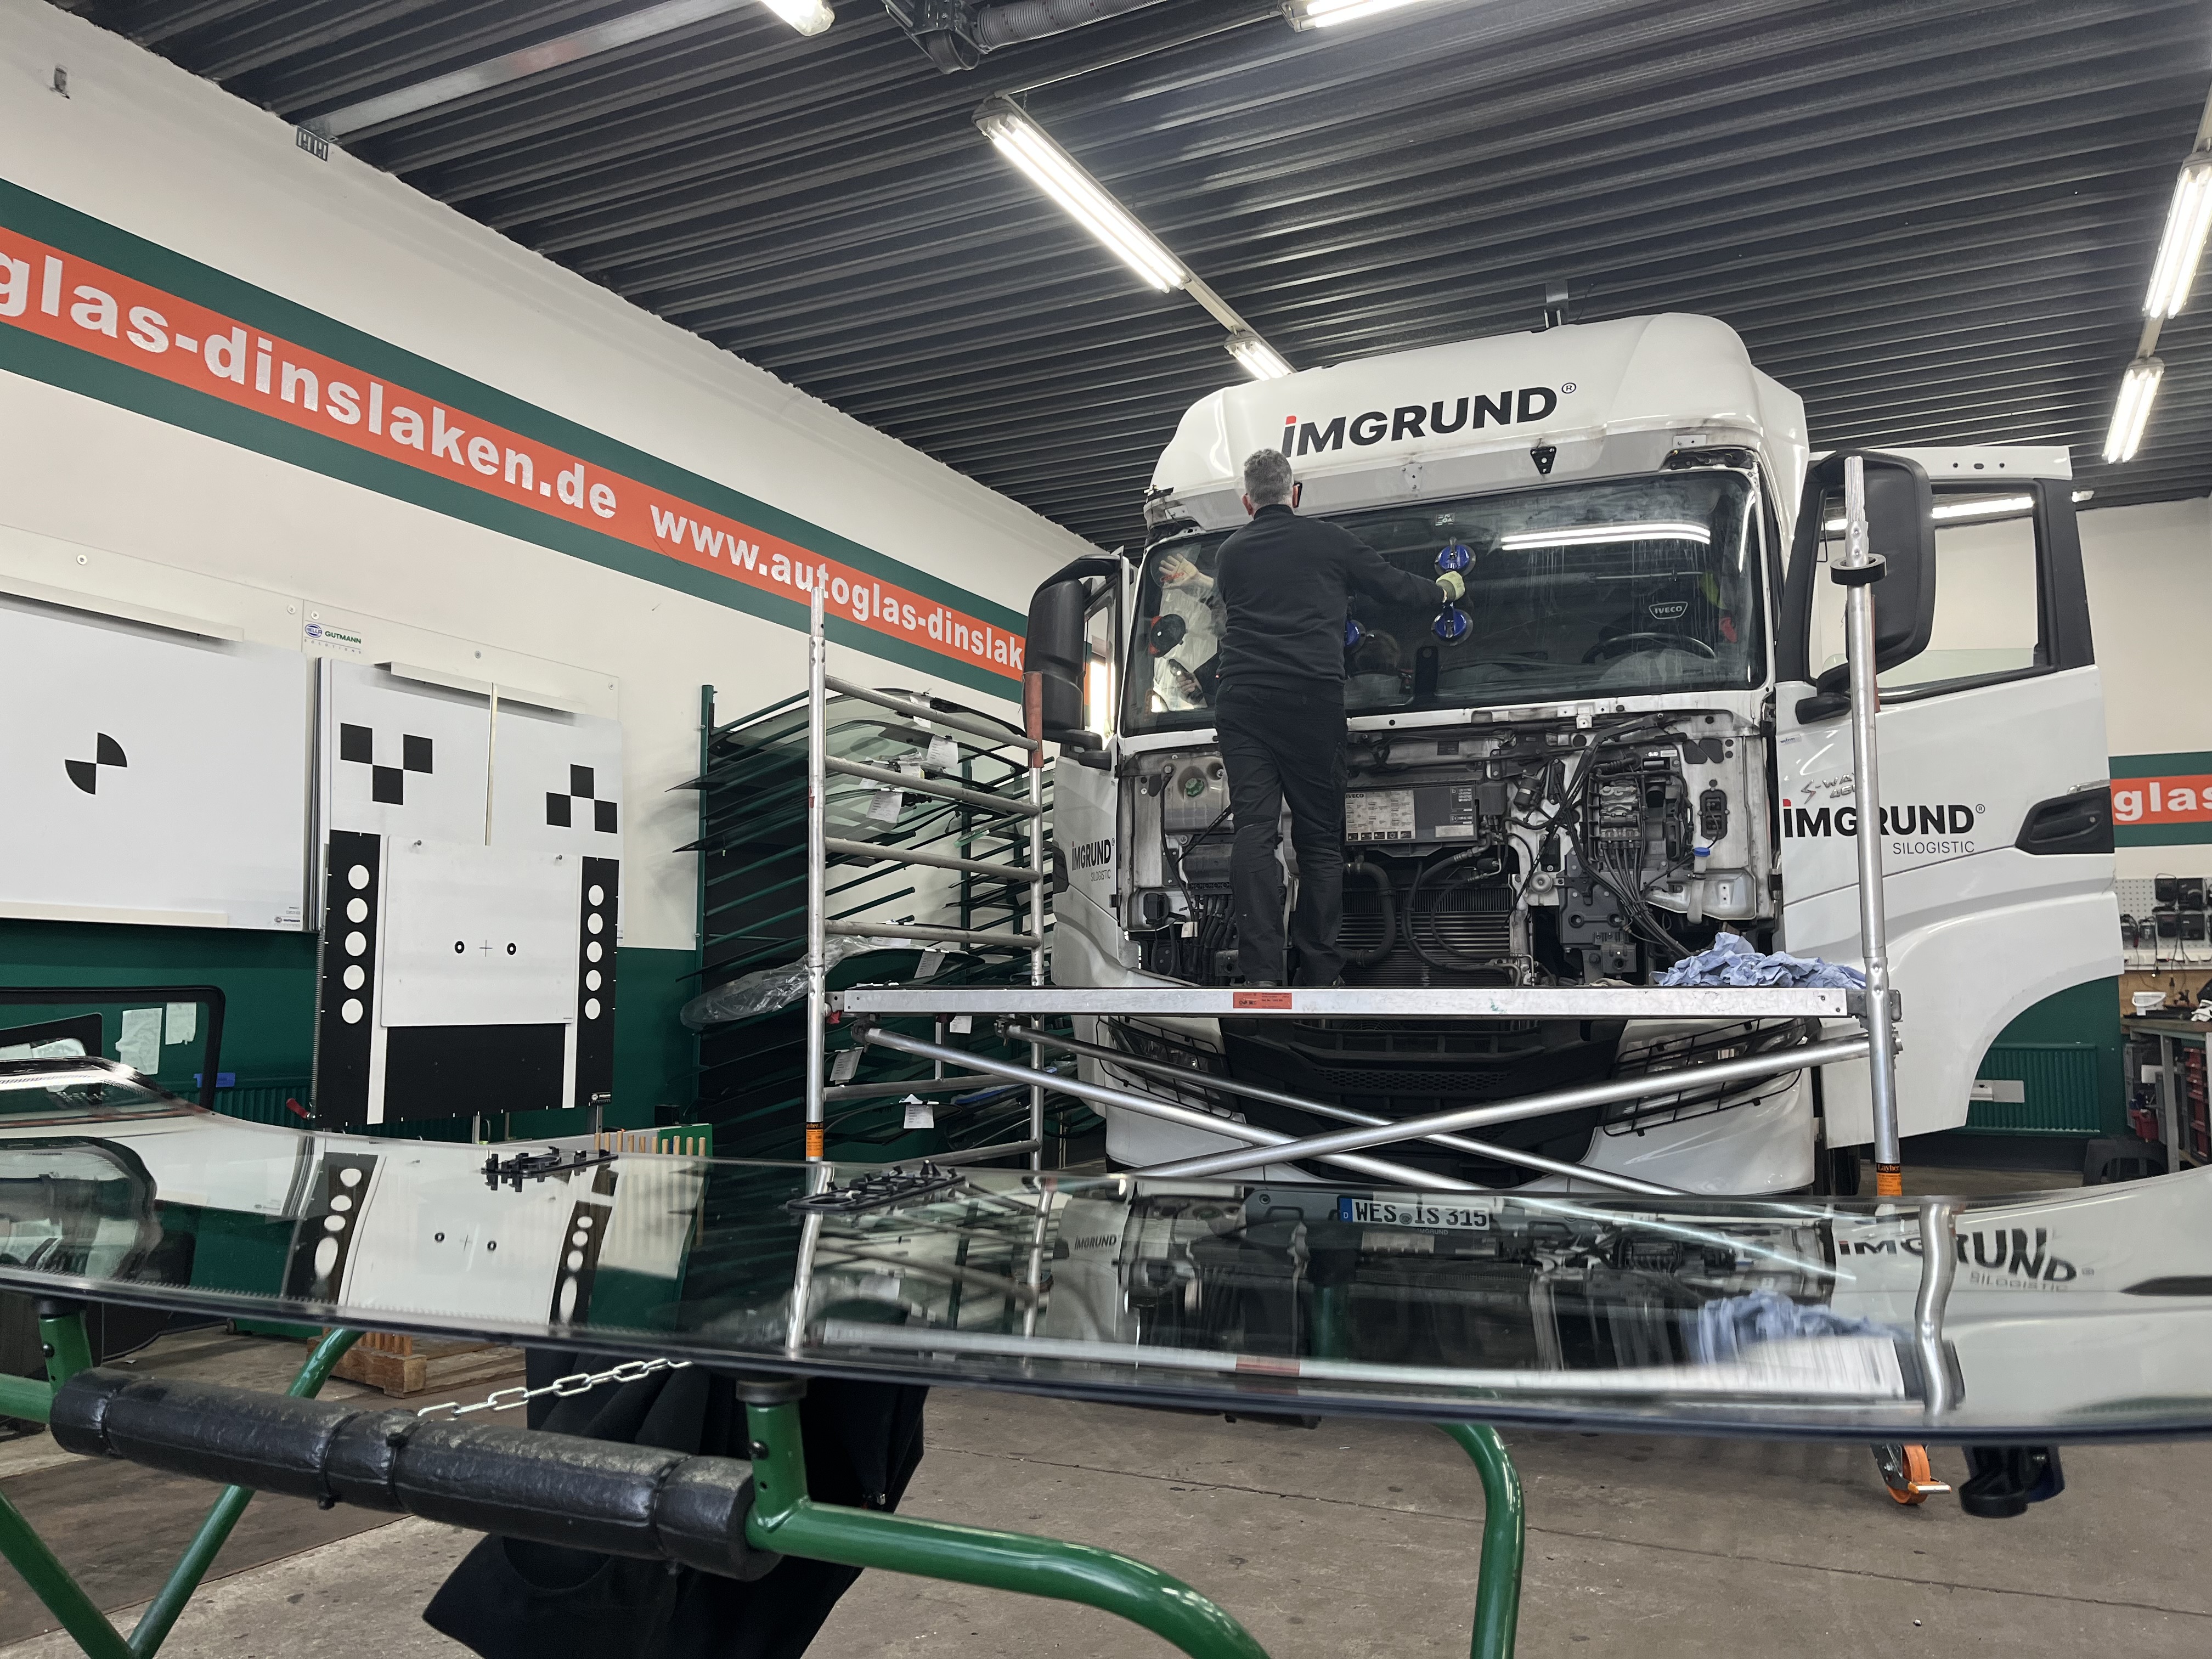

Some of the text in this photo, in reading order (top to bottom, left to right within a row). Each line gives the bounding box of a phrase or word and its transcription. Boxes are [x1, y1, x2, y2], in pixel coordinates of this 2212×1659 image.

[1655, 606, 1683, 614] IVECO
[325, 631, 362, 644] GUTMANN
[1801, 772, 1855, 804] S-WA
[1893, 841, 1974, 855] SILOGISTIC
[1091, 869, 1111, 882] SILOGISTIC
[1355, 1202, 1397, 1222] WES
[1415, 1206, 1440, 1224] IS
[1445, 1208, 1487, 1227] 315
